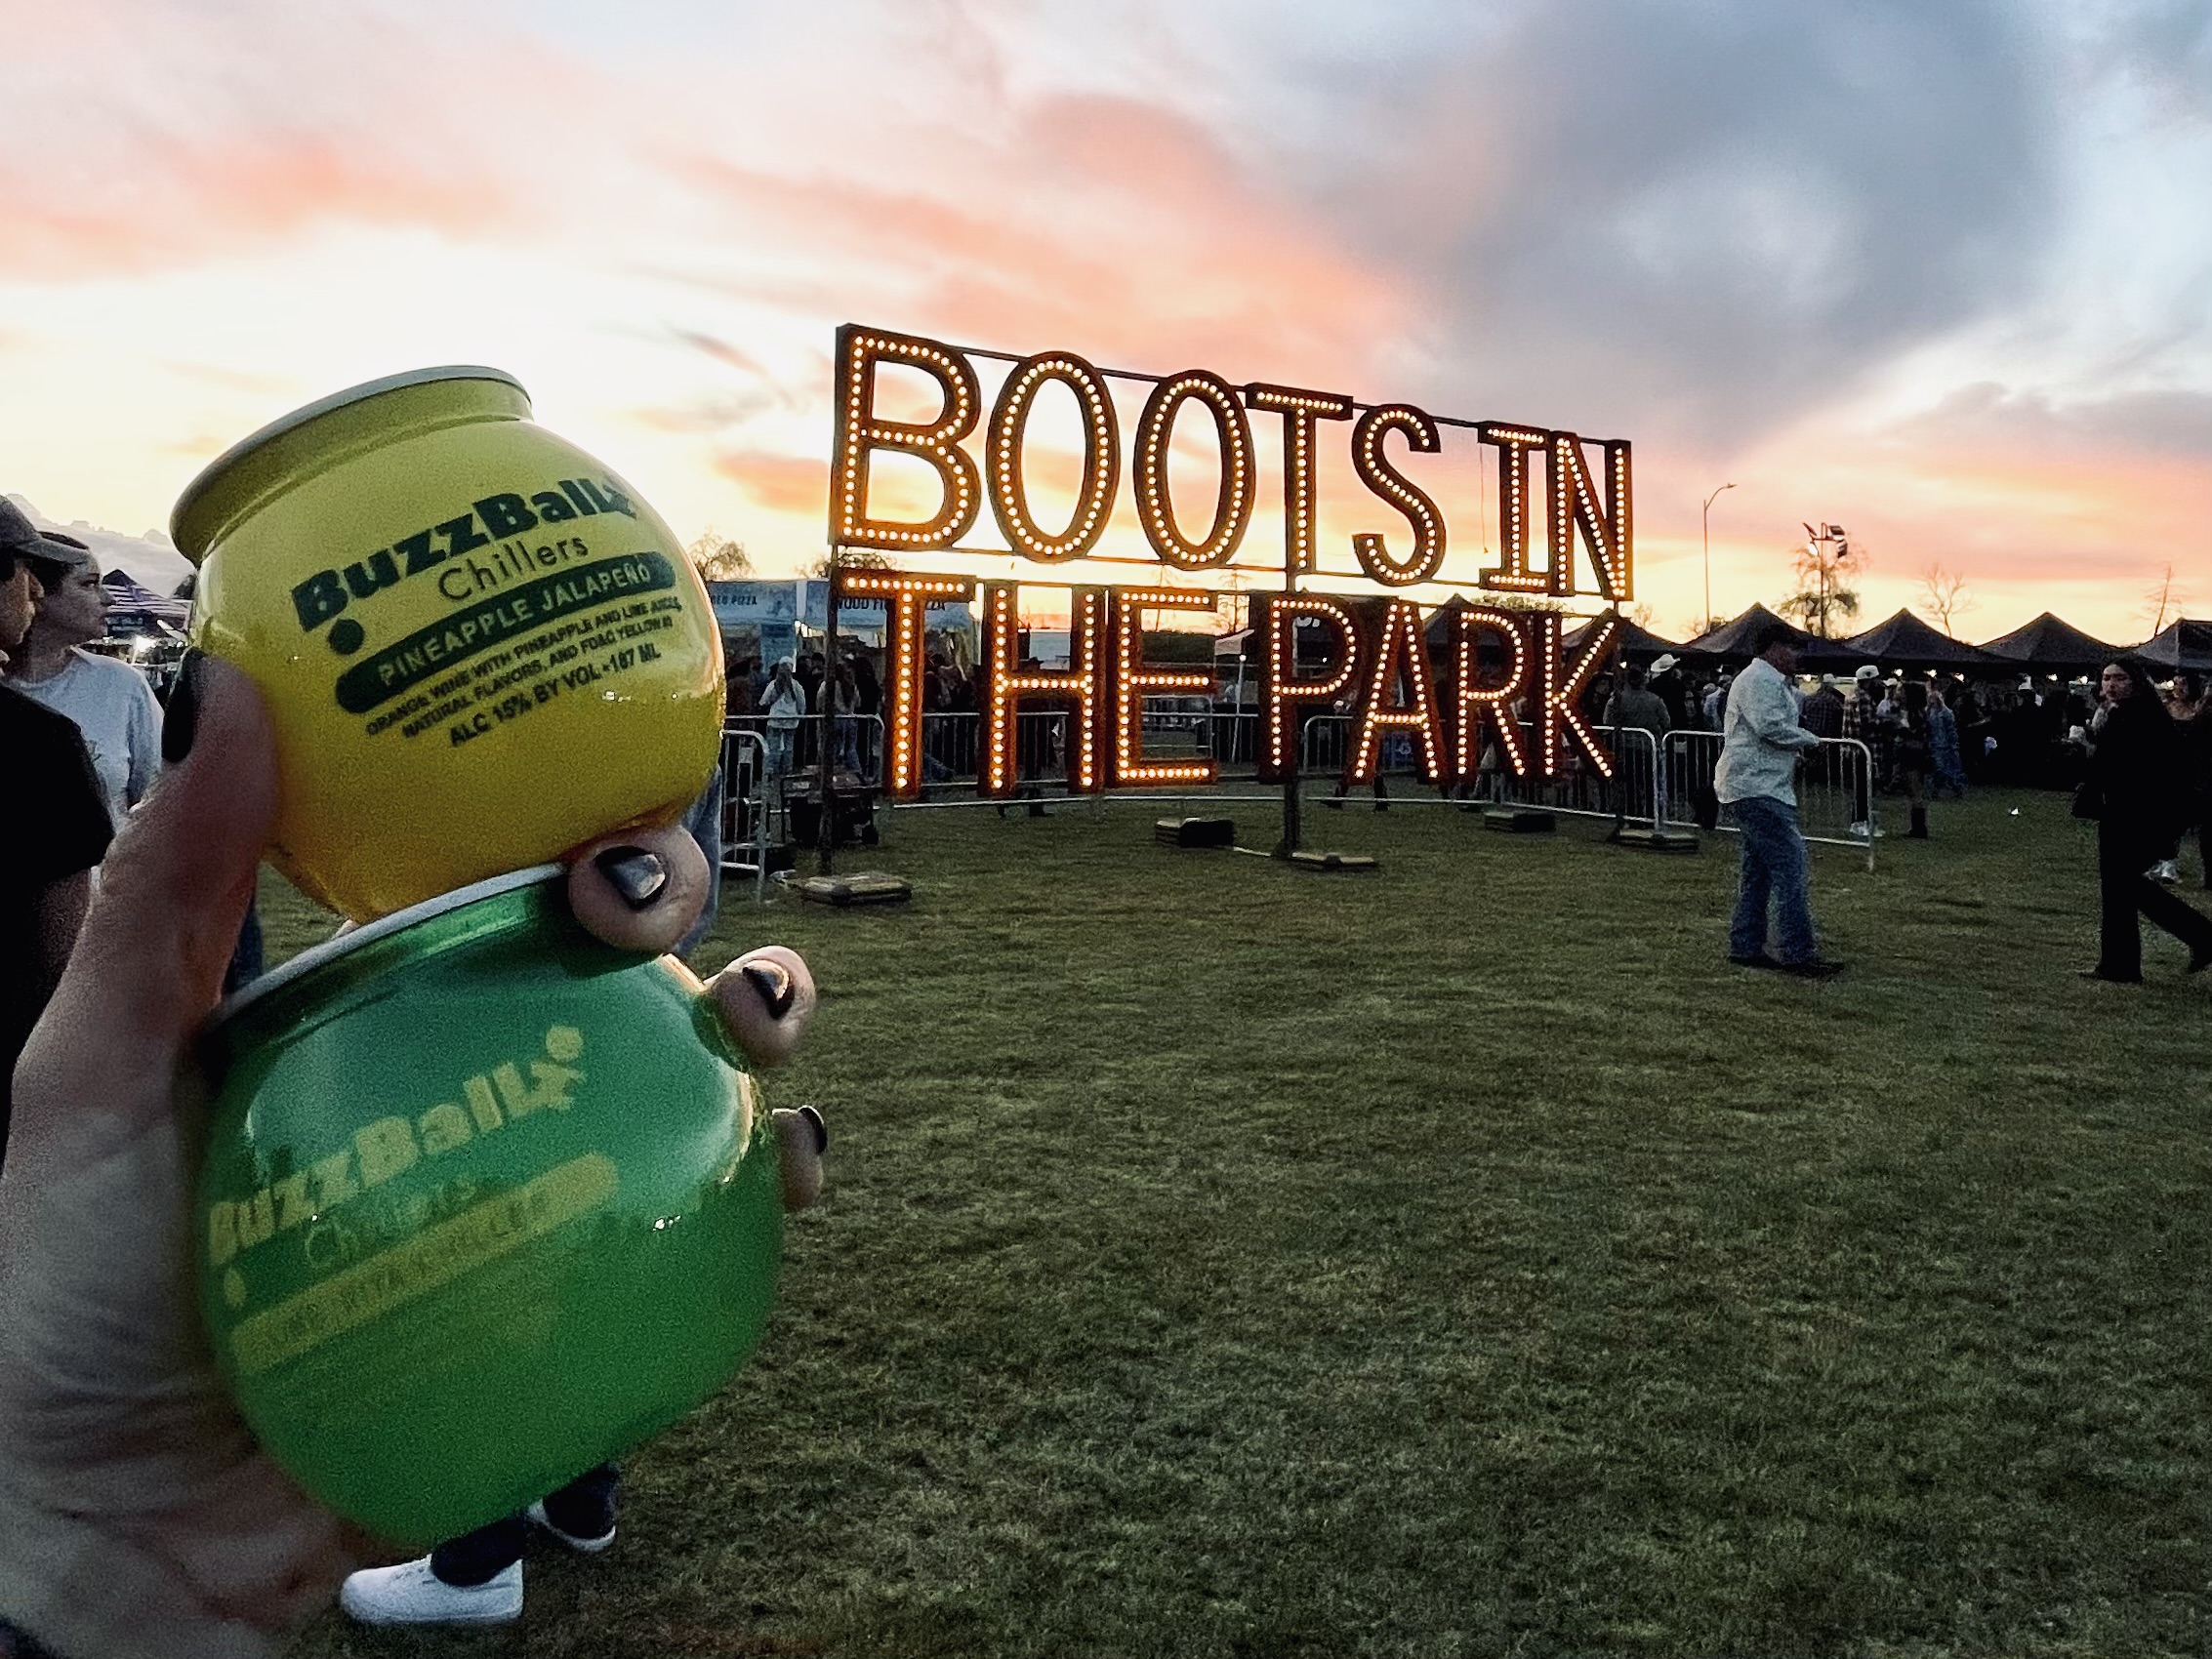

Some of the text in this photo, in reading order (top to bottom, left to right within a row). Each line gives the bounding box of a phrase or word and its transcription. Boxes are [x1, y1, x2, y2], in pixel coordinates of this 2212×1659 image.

[830, 323, 1634, 600] BOOTS IN
[439, 536, 589, 601] Chillers
[378, 598, 534, 685] PINEAPPLE
[837, 568, 1616, 799] THE PARK
[533, 678, 557, 703] BY
